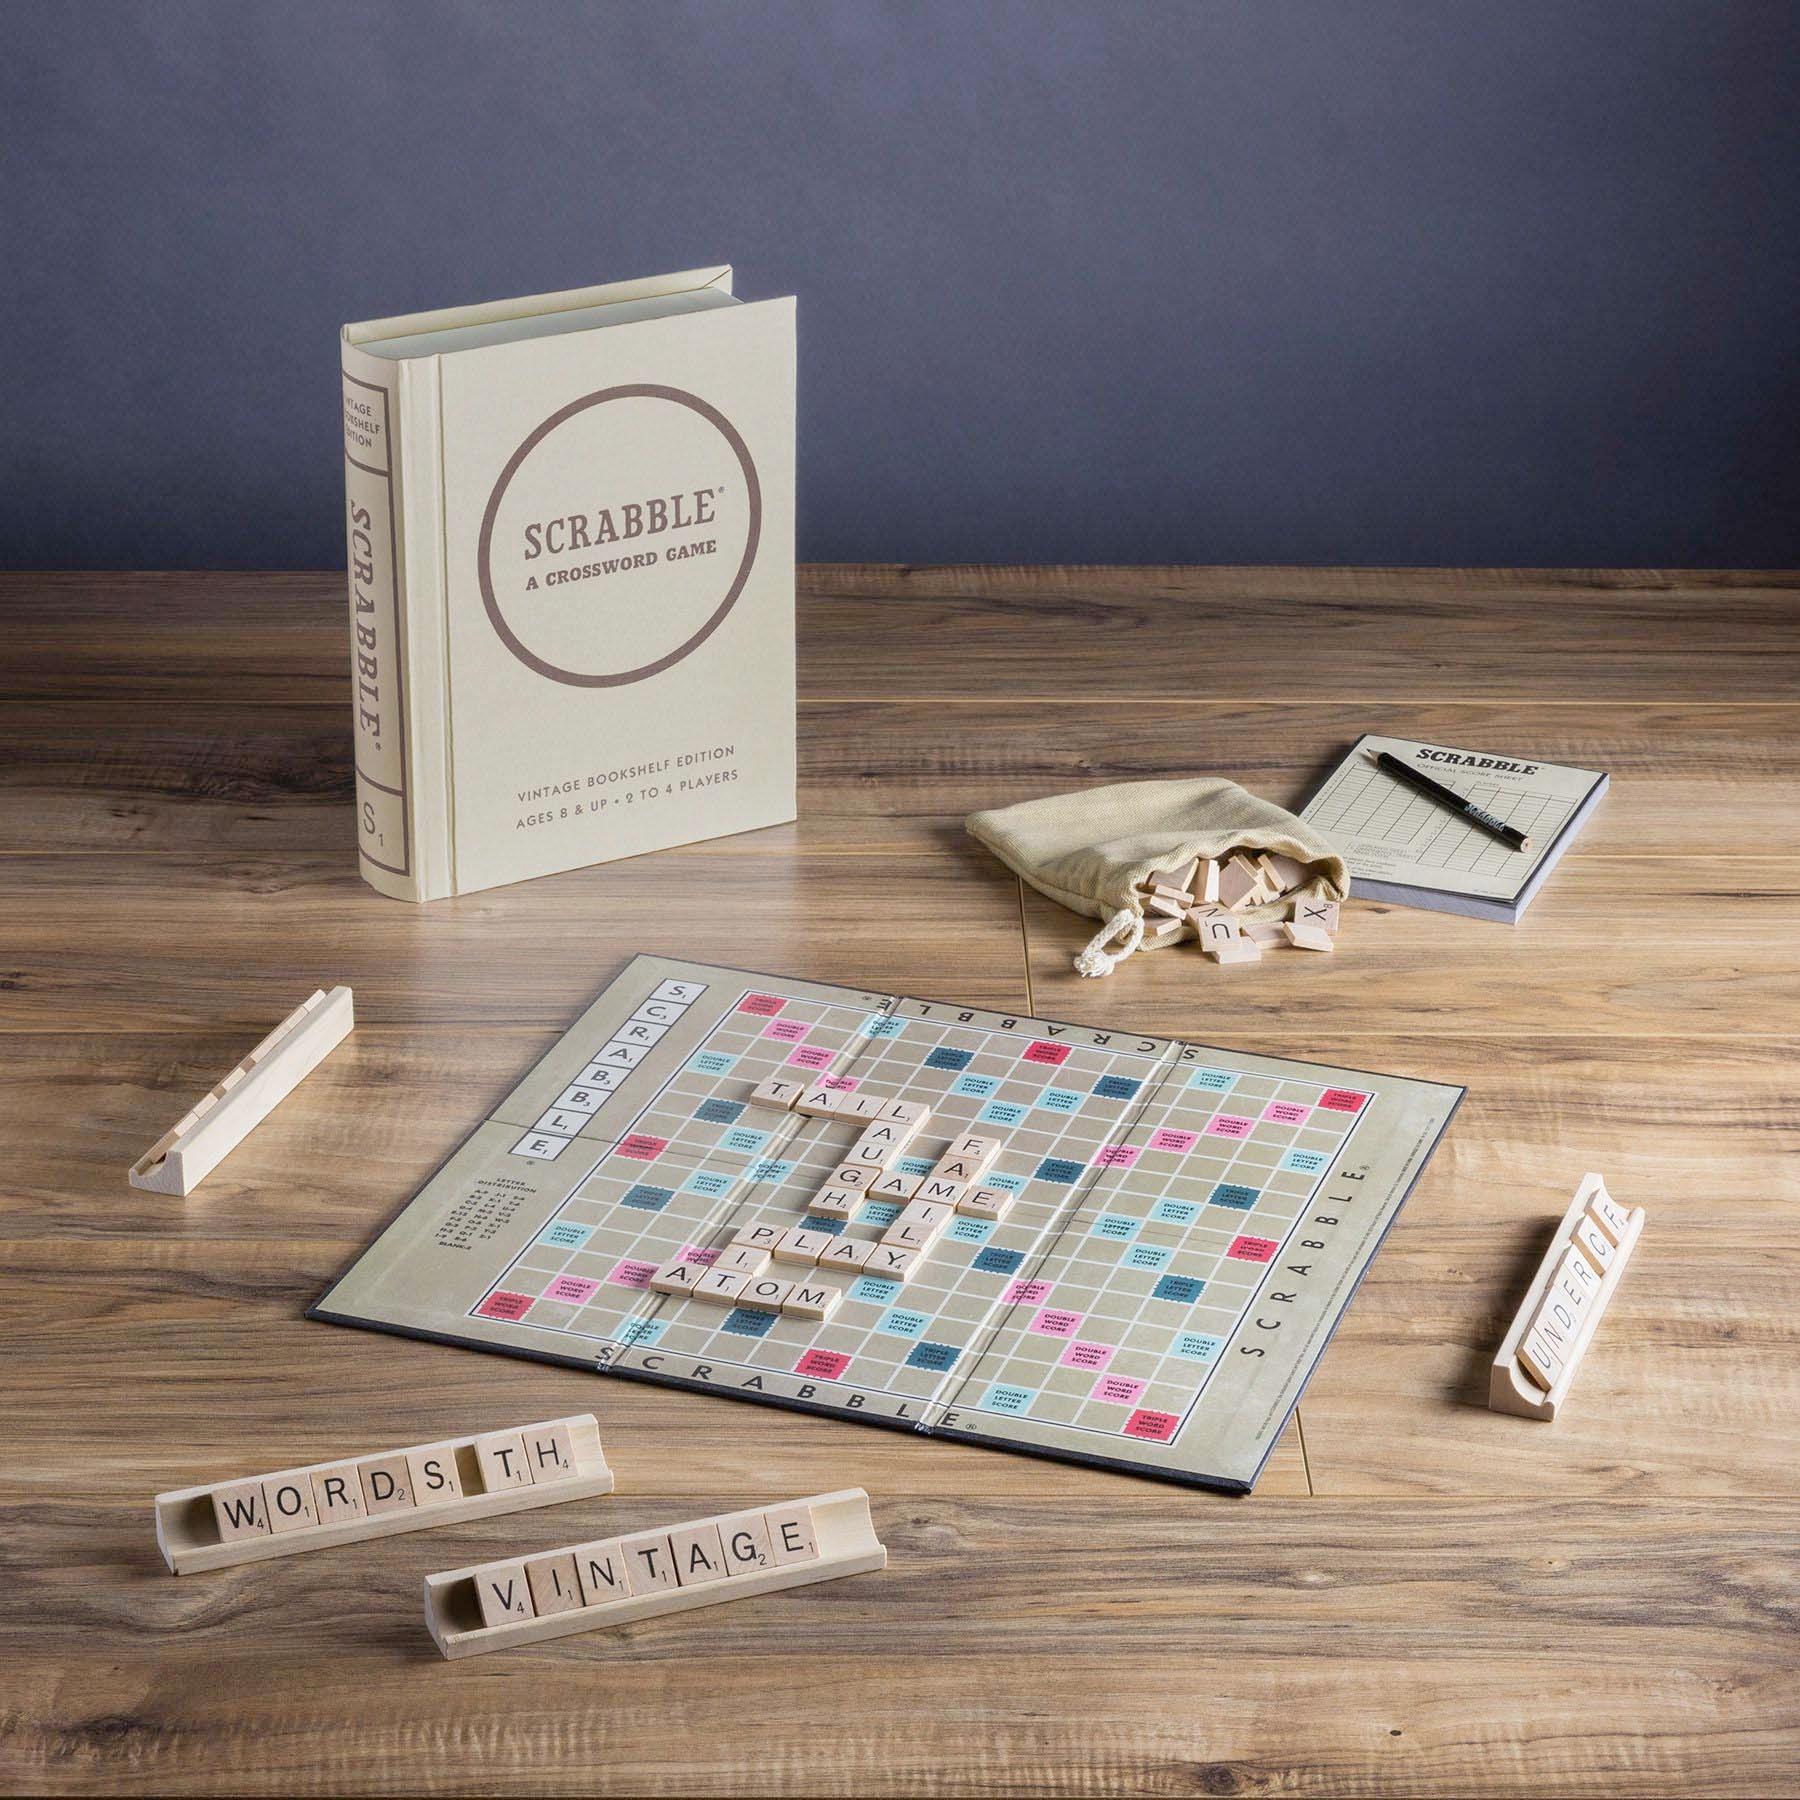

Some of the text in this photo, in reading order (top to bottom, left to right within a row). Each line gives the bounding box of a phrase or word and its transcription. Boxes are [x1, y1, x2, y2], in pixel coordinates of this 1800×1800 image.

[526, 540, 716, 590] A CROSSWORD GAME
[1416, 749, 1538, 776] SCRABBLE
[518, 746, 734, 802] VINTAGE BOOKSHELF EDITION
[516, 811, 553, 829] AGES
[560, 808, 568, 819] 8
[590, 800, 607, 812] UP
[626, 792, 634, 804] 2
[640, 787, 658, 800] TO
[666, 784, 672, 794] 4
[680, 770, 738, 791] PLAYERS
[1219, 1118, 1248, 1126] DOUBLE
[733, 1132, 762, 1140] DOUBLE
[1162, 1132, 1191, 1140] DOUBLE
[1293, 1153, 1322, 1161] DOUBLE
[958, 1221, 988, 1229] DOUBLE
[1104, 1218, 1135, 1226] DOUBLE
[555, 1226, 586, 1234] DOUBLE
[863, 1281, 895, 1290] DOUBLE
[892, 1314, 924, 1322] DOUBLE
[1044, 1314, 1076, 1322] DOUBLE
[1043, 1319, 1070, 1327] WORD
[1040, 1324, 1066, 1332] SCORE
[1184, 1337, 1216, 1346] DOUBLE
[1074, 1346, 1106, 1355] DOUBLE
[1180, 1348, 1207, 1356] SCORE
[1074, 1352, 1101, 1360] WORD
[1071, 1357, 1097, 1365] SCORE
[1106, 1380, 1139, 1389] DOUBLE
[1106, 1386, 1133, 1394] WORD
[995, 1390, 1028, 1399] DOUBLE
[1103, 1391, 1130, 1399] SCORE
[994, 1396, 1022, 1404] LETTER
[991, 1401, 1018, 1409] SCORE
